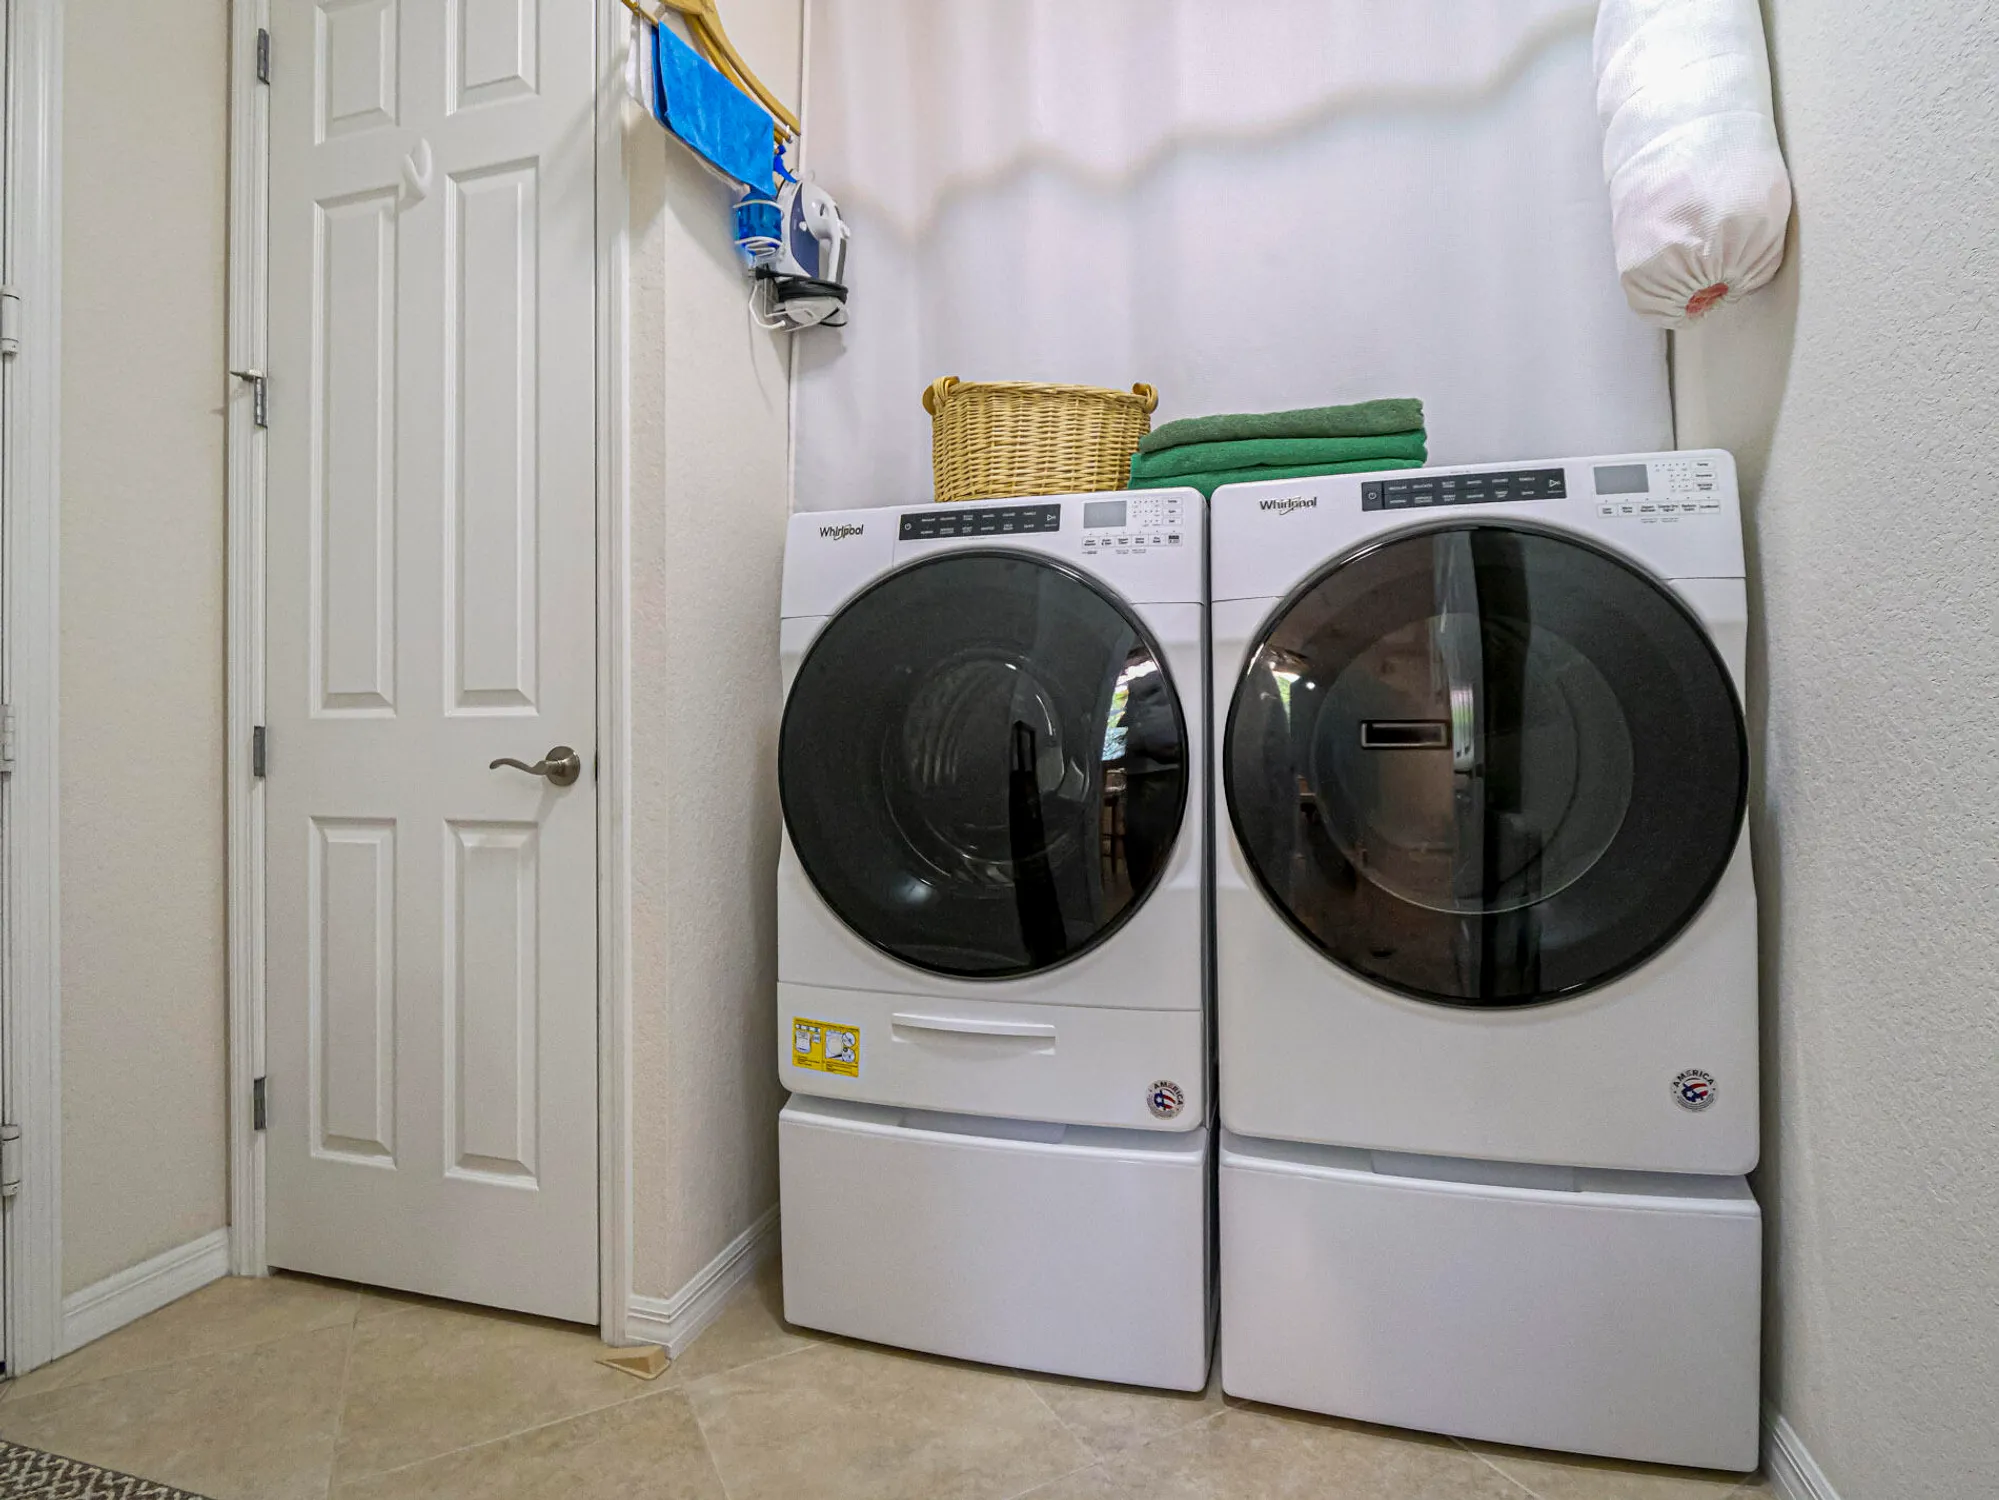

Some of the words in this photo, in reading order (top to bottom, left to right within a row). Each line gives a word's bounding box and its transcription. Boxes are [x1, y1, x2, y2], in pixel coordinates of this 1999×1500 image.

[1259, 496, 1317, 515] Whirlpool
[819, 523, 864, 541] Whirlpool
[1673, 1069, 1715, 1088] AMERICA
